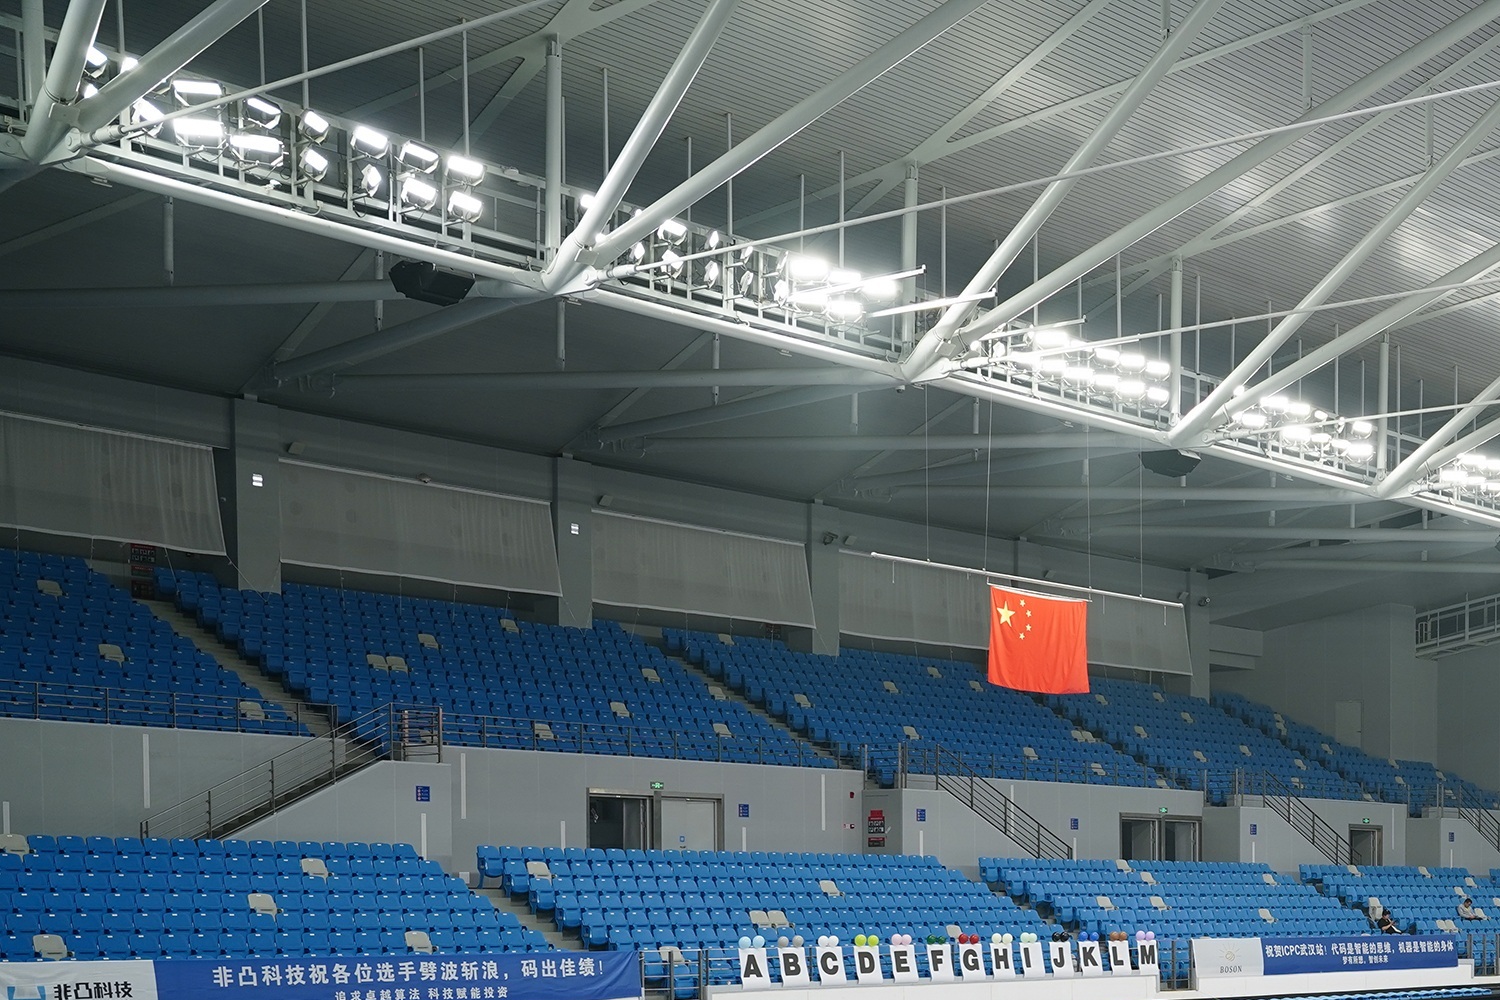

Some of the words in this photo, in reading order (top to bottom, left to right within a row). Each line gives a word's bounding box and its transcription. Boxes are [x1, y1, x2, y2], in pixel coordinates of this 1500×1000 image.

[744, 954, 763, 978] A
[782, 953, 801, 976] B
[820, 952, 839, 975] C
[858, 952, 875, 973] D
[894, 951, 910, 972] E
[931, 950, 944, 971] F
[963, 949, 979, 971] G
[994, 948, 1010, 969] H
[1024, 948, 1032, 968] I
[1053, 947, 1065, 968] J
[1082, 947, 1098, 967] K
[1112, 946, 1124, 966] L
[1140, 945, 1155, 965] M
[1219, 965, 1242, 974] BOSON
[54, 981, 133, 1000] 非凸科技
[428, 986, 508, 1000] 科技赋能投资
